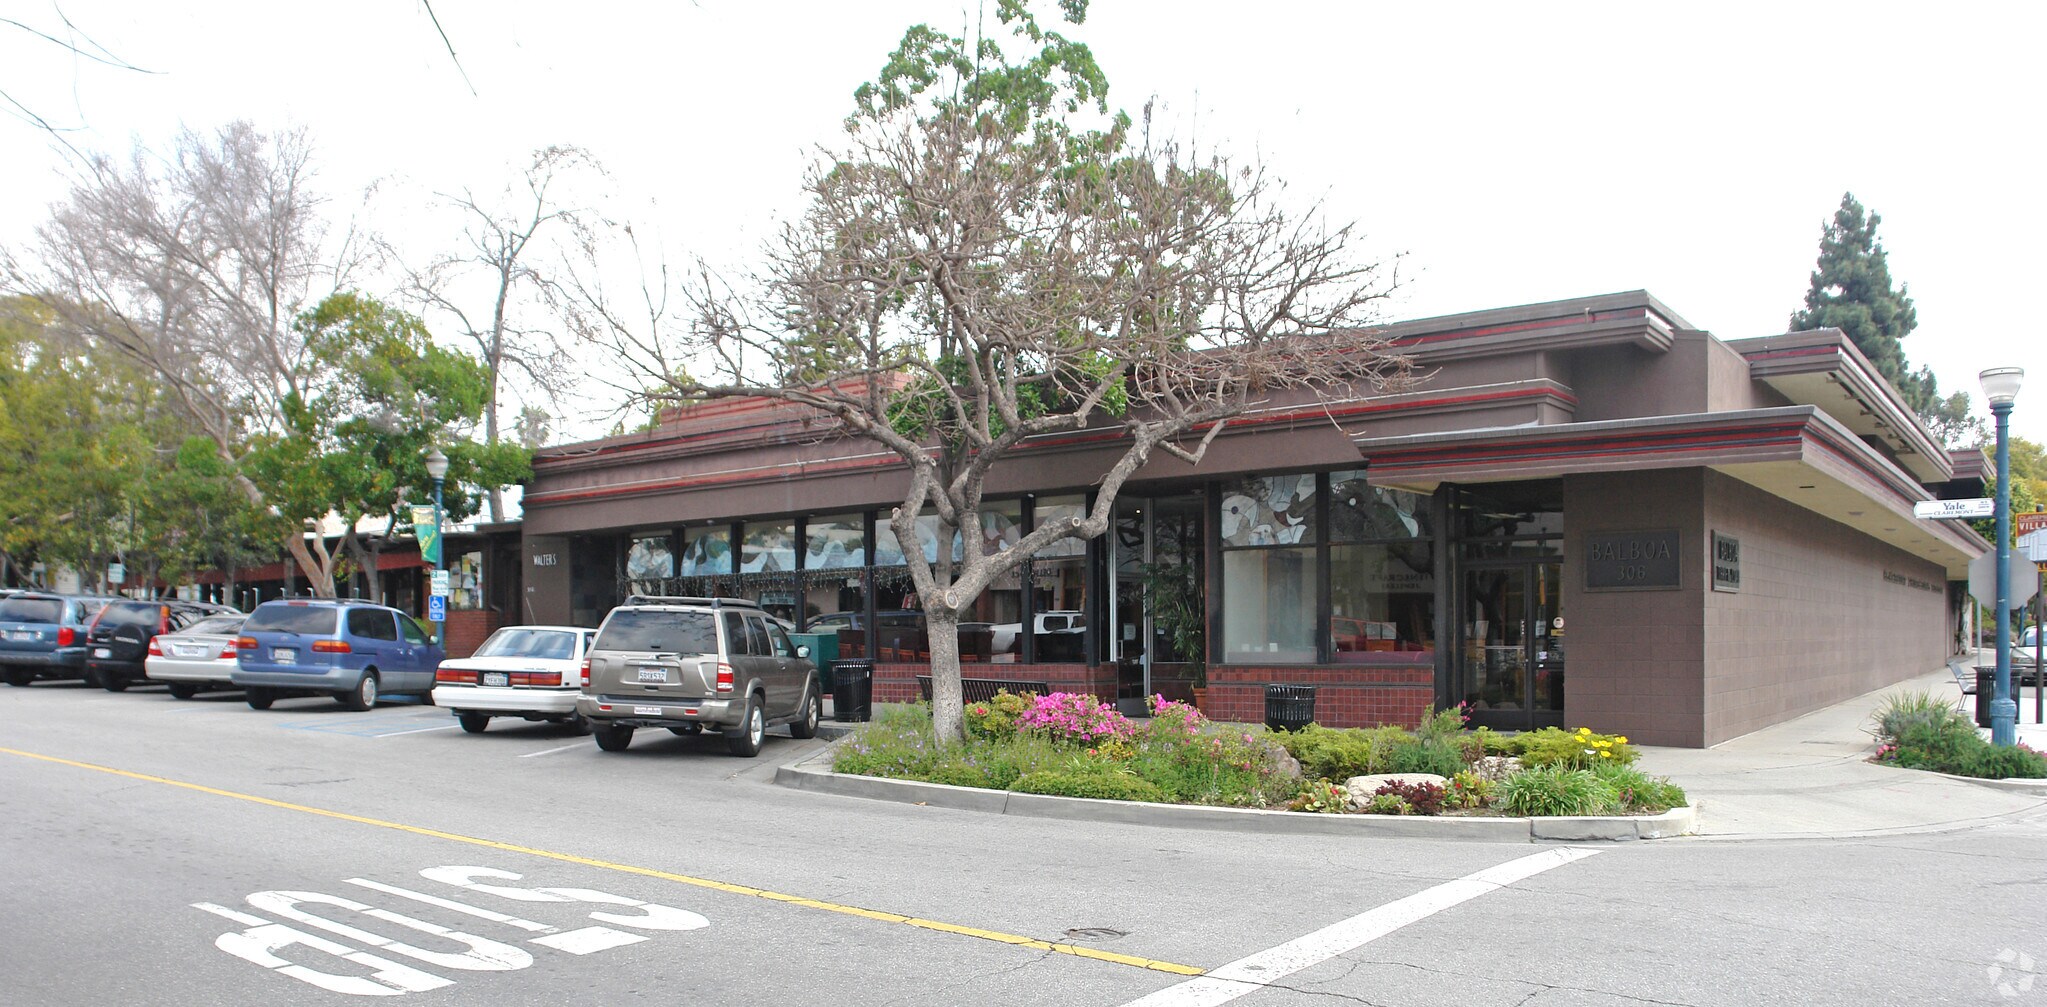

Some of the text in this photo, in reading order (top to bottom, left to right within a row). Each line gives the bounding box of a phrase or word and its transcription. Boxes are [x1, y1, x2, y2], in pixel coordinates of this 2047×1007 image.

[1943, 502, 1965, 511] Yale
[1592, 540, 1670, 561] BALBOA
[1617, 565, 1646, 580] 306
[190, 865, 711, 996] STOP
